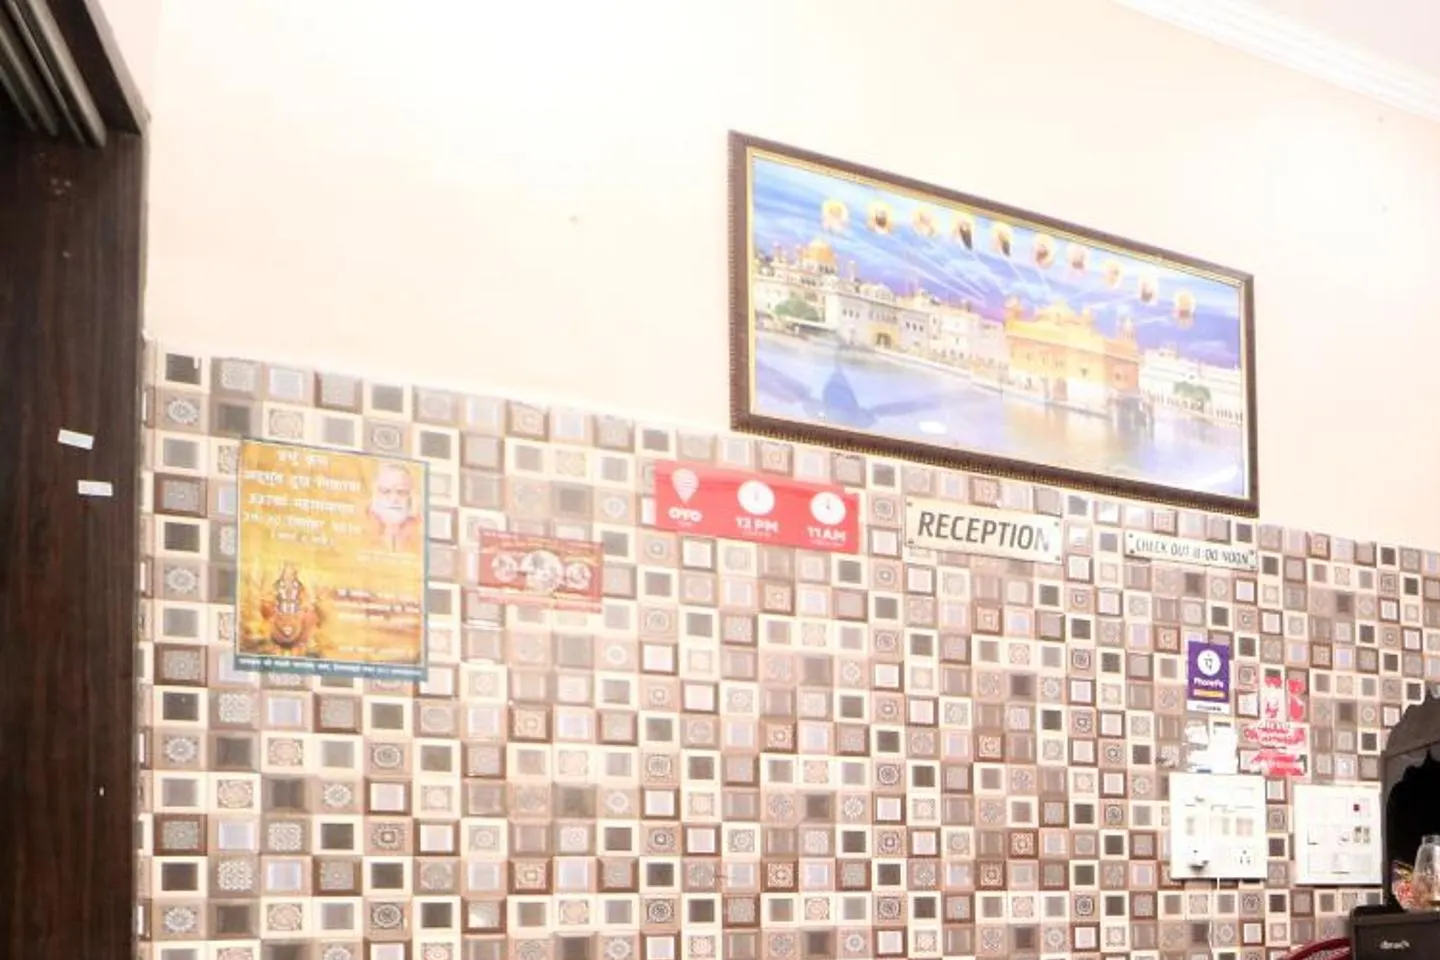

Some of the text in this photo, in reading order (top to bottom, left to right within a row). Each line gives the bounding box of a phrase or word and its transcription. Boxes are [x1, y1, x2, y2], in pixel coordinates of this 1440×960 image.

[754, 518, 779, 533] PM
[917, 511, 1050, 552] RECEPTION
[822, 528, 847, 543] AM
[1136, 539, 1168, 554] CHECK
[1171, 542, 1190, 556] OUT
